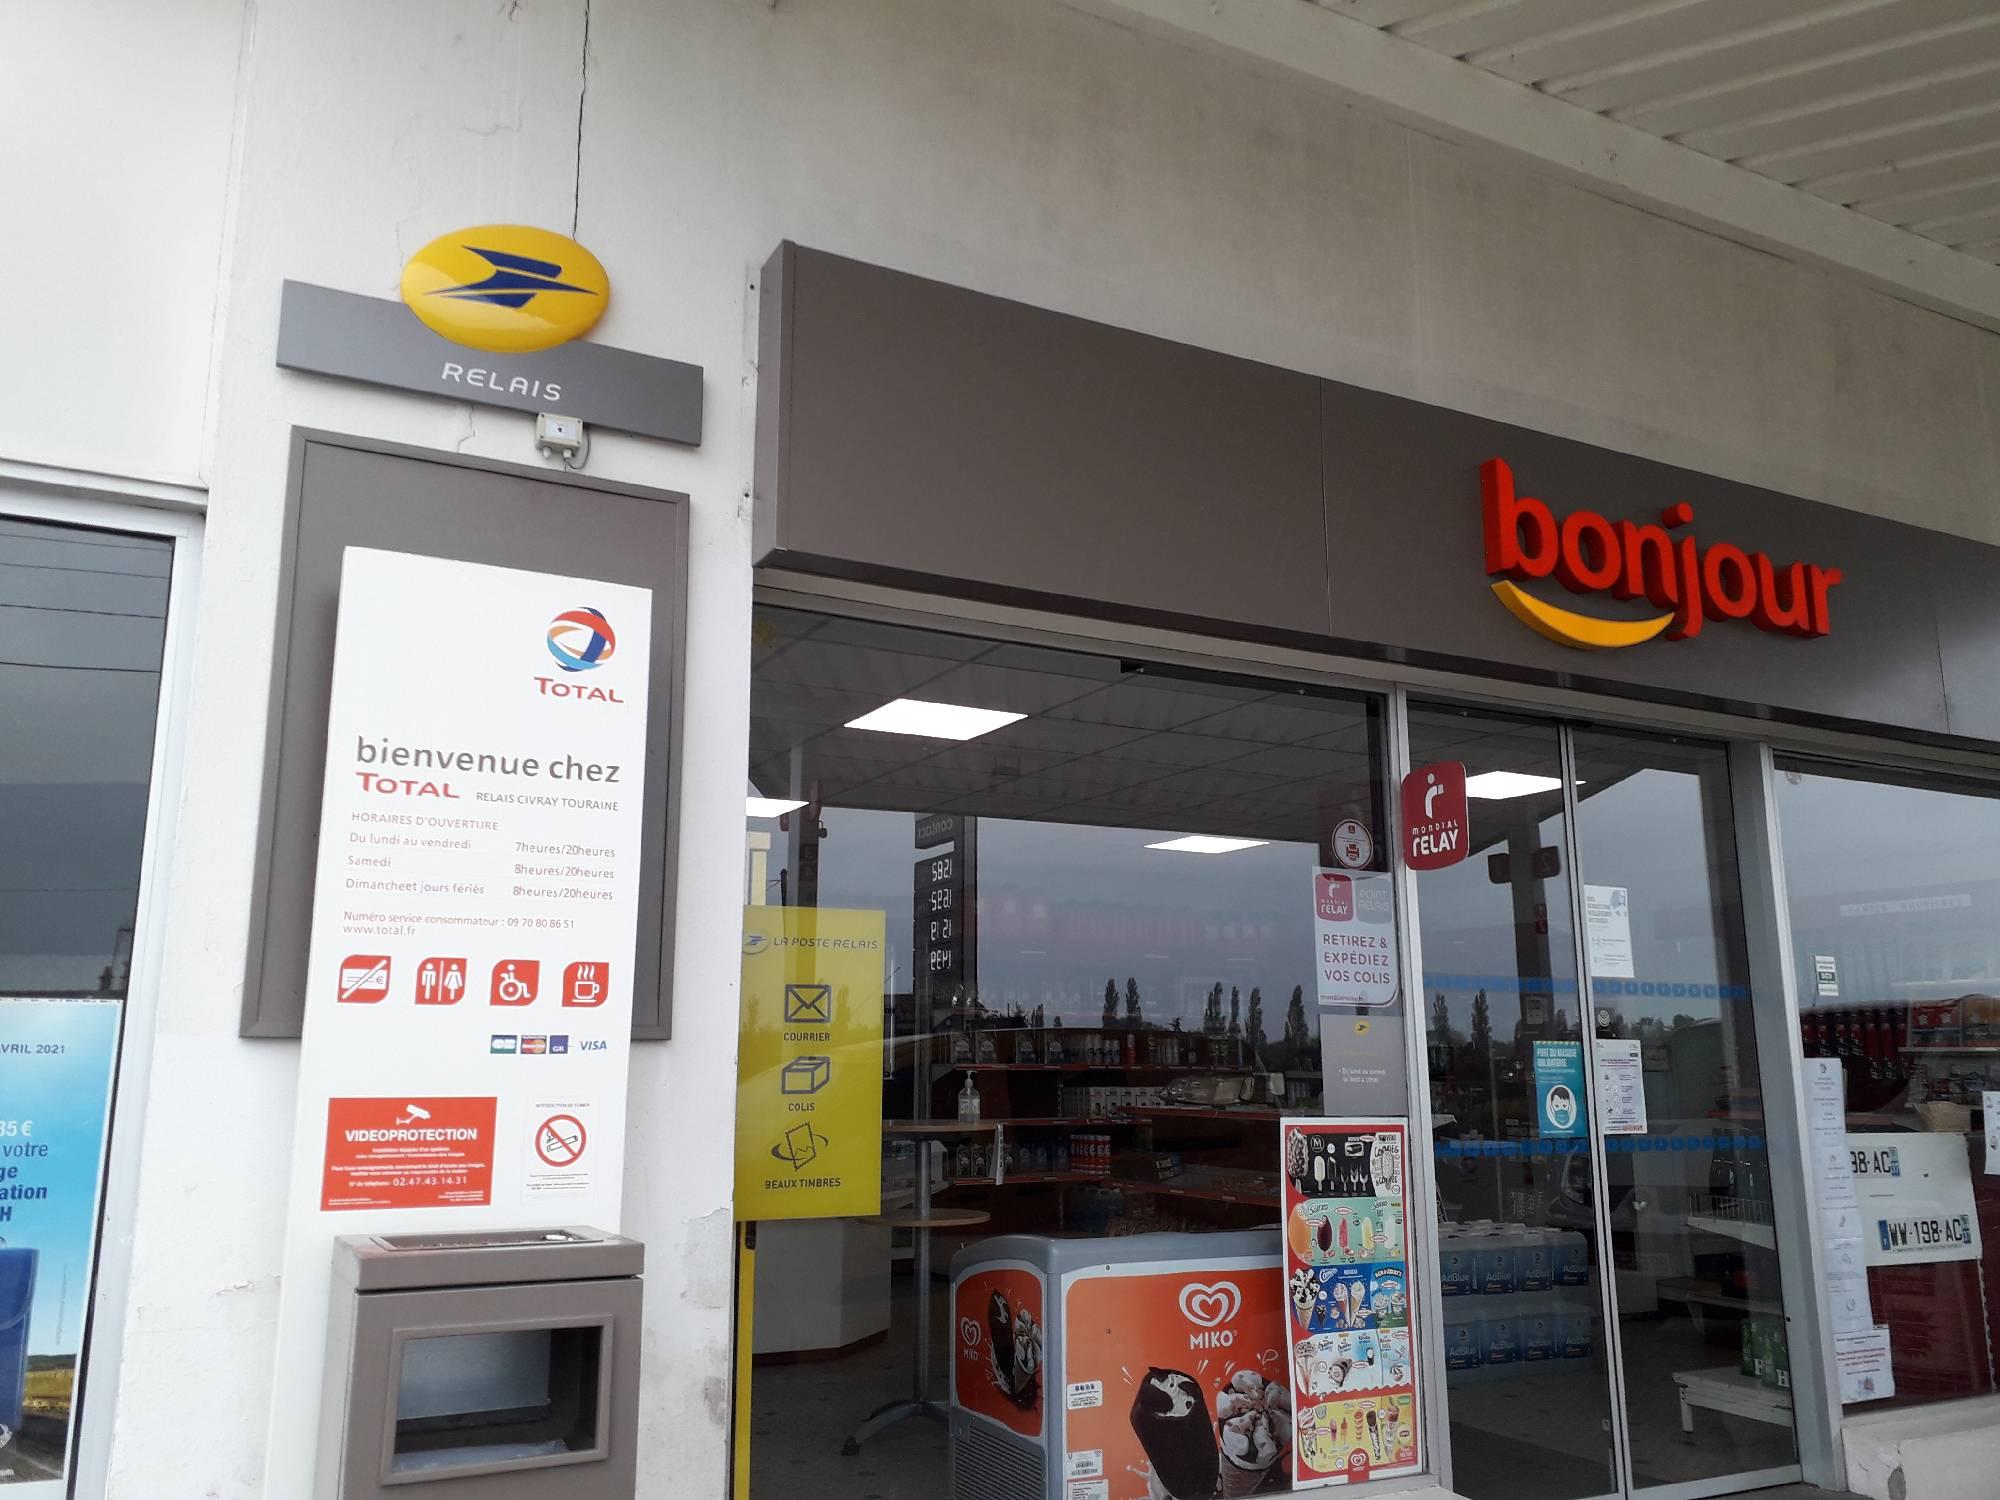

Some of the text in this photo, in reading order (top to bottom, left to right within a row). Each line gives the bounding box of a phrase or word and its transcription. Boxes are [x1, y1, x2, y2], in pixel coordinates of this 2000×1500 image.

[441, 361, 562, 401] RELAIS
[1479, 456, 1843, 641] bonjour
[533, 676, 625, 704] TOTAL
[356, 735, 621, 783] bienvenue chez
[356, 771, 619, 811] TOTAL RELAIS CIVRAY TOURAINE
[351, 811, 499, 831] HORAIRES D'OUVERTURE
[350, 832, 471, 850] Du lundi au vendredi
[515, 841, 616, 858] 7heures/20heures
[347, 855, 392, 868] Samedi
[420, 881, 449, 895] jours
[343, 910, 386, 923] Numéro
[388, 912, 423, 924] service
[425, 914, 499, 927] consommateur
[507, 916, 519, 928] 09
[521, 917, 533, 929] 70
[535, 918, 548, 929] 80
[549, 918, 562, 929] 86
[563, 918, 575, 930] 51
[343, 923, 416, 937] www.total.fr
[773, 937, 878, 950] LA POSTE RELAIS
[1323, 933, 1388, 949] RETIREZ &
[1324, 950, 1389, 967] EXPÉDIEZ
[1324, 968, 1391, 985] VOS COLIS
[783, 1031, 831, 1043] COURRIER
[0, 1043, 65, 1054] VRIL 2021
[580, 1040, 607, 1051] VISA
[788, 1102, 816, 1112] COLIS
[345, 1127, 478, 1142] VIDEOPROTECTION
[3, 1141, 49, 1157] votre
[765, 1177, 841, 1190] BEAUX TIMBRES
[1189, 1330, 1233, 1350] MIKO
